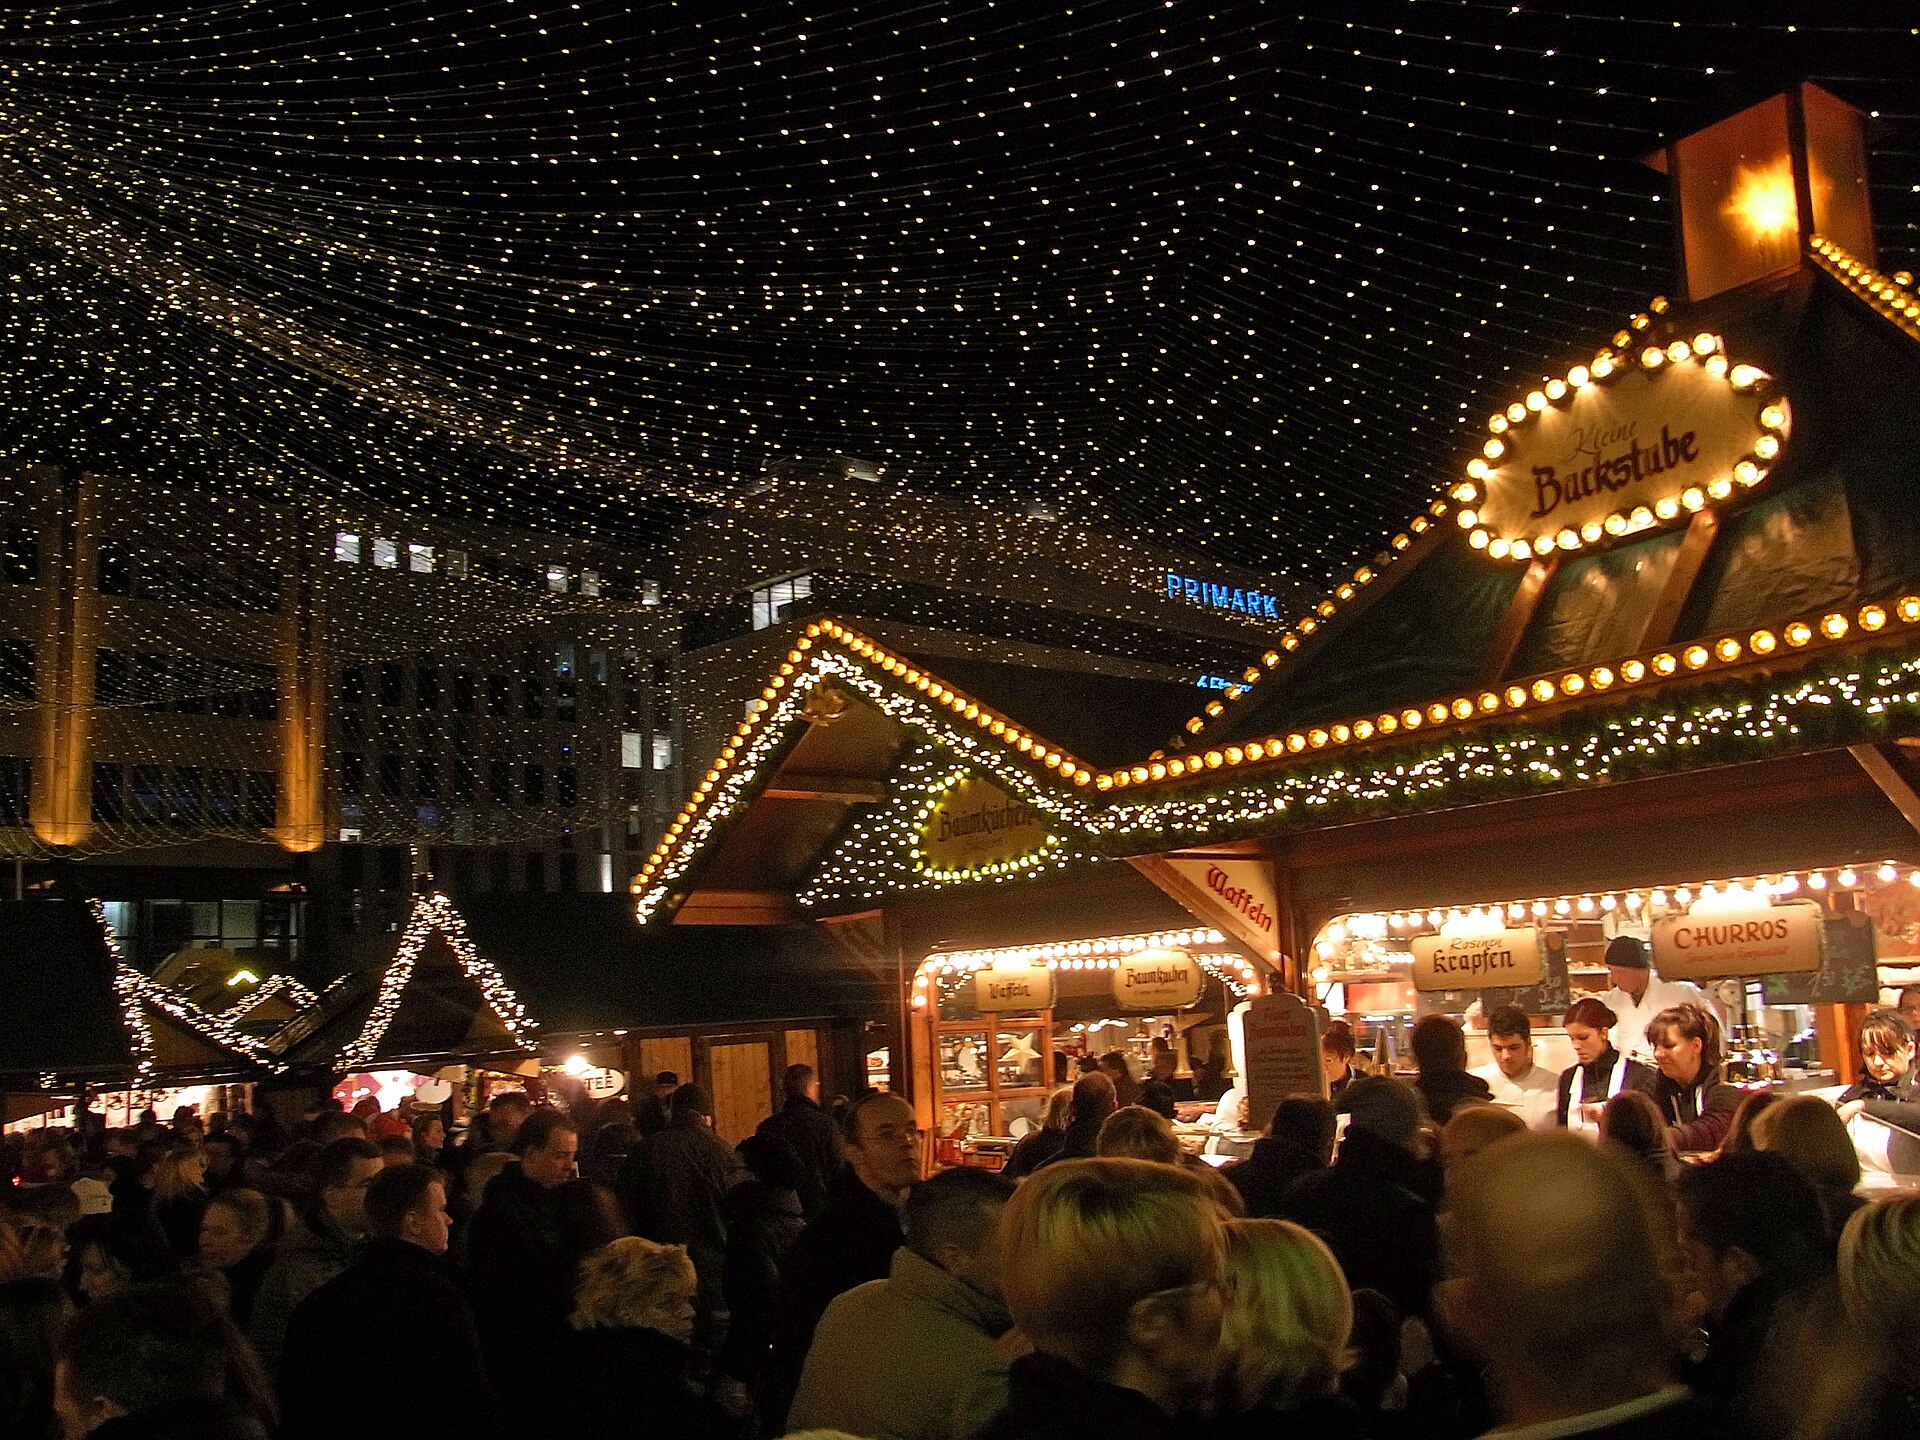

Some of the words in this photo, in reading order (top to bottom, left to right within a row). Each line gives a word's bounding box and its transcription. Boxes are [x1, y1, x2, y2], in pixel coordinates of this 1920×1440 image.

[1530, 424, 1698, 519] Backstube
[1167, 573, 1279, 619] PRIMARK
[1207, 863, 1272, 932] Waffeln
[1674, 919, 1788, 949] CHURROS
[584, 1076, 614, 1090] TEE
